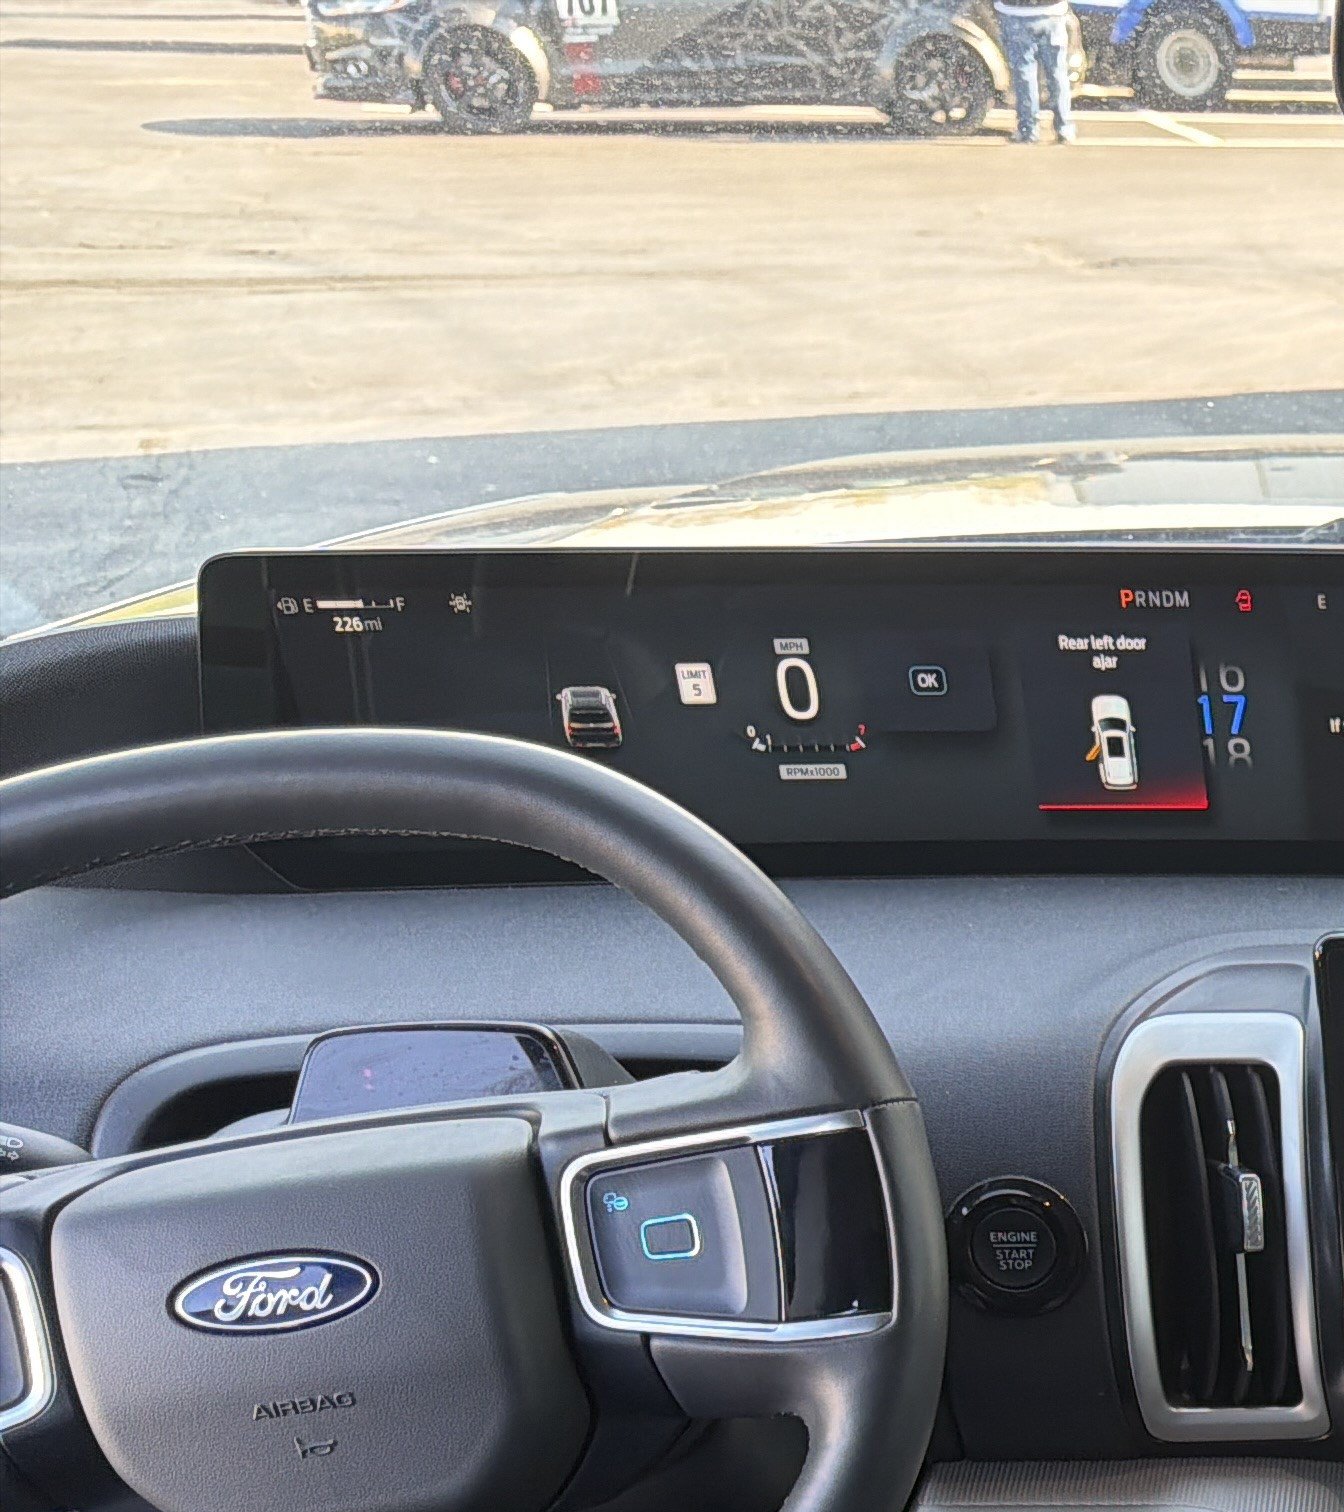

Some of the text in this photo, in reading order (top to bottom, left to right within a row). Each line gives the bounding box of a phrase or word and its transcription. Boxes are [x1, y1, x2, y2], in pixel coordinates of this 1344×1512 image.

[779, 642, 804, 651] MPH
[1058, 634, 1147, 650] Rear left door
[1092, 654, 1118, 671] ajar
[681, 670, 707, 680] LIMIT
[917, 673, 939, 689] OK
[692, 684, 702, 697] 5
[776, 657, 819, 720] 0
[1197, 694, 1247, 735] 17
[1329, 717, 1341, 733] If
[989, 1231, 1038, 1243] ENGINE
[995, 1249, 1035, 1260] START
[999, 1259, 1033, 1271] STOP
[214, 1266, 333, 1322] Ford
[252, 1391, 356, 1421] AIRBAG
